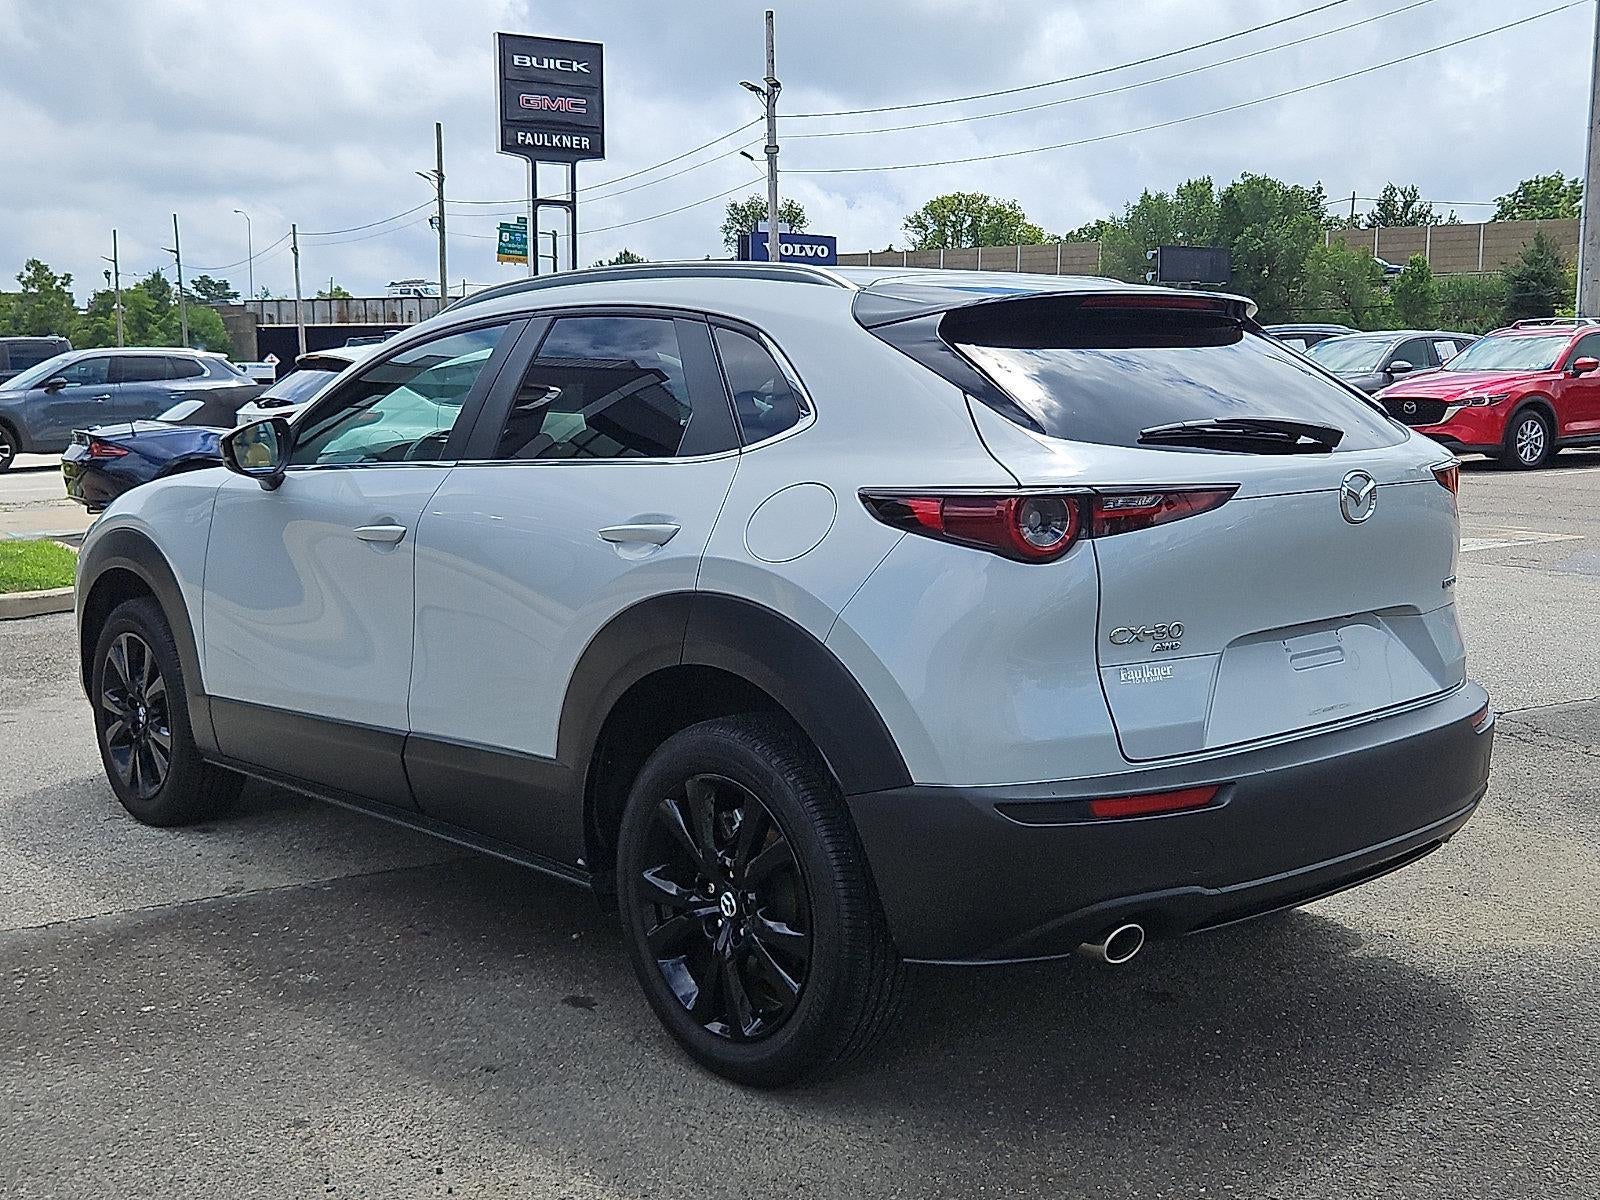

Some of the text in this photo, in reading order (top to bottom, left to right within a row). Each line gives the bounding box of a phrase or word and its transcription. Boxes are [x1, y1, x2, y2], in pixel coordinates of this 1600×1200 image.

[512, 54, 591, 74] BUICK
[519, 93, 587, 114] GMC
[517, 131, 590, 150] FAULKNER
[1109, 621, 1185, 645] CX-30
[1151, 640, 1182, 654] AWD
[1120, 665, 1173, 681] Faulkner
